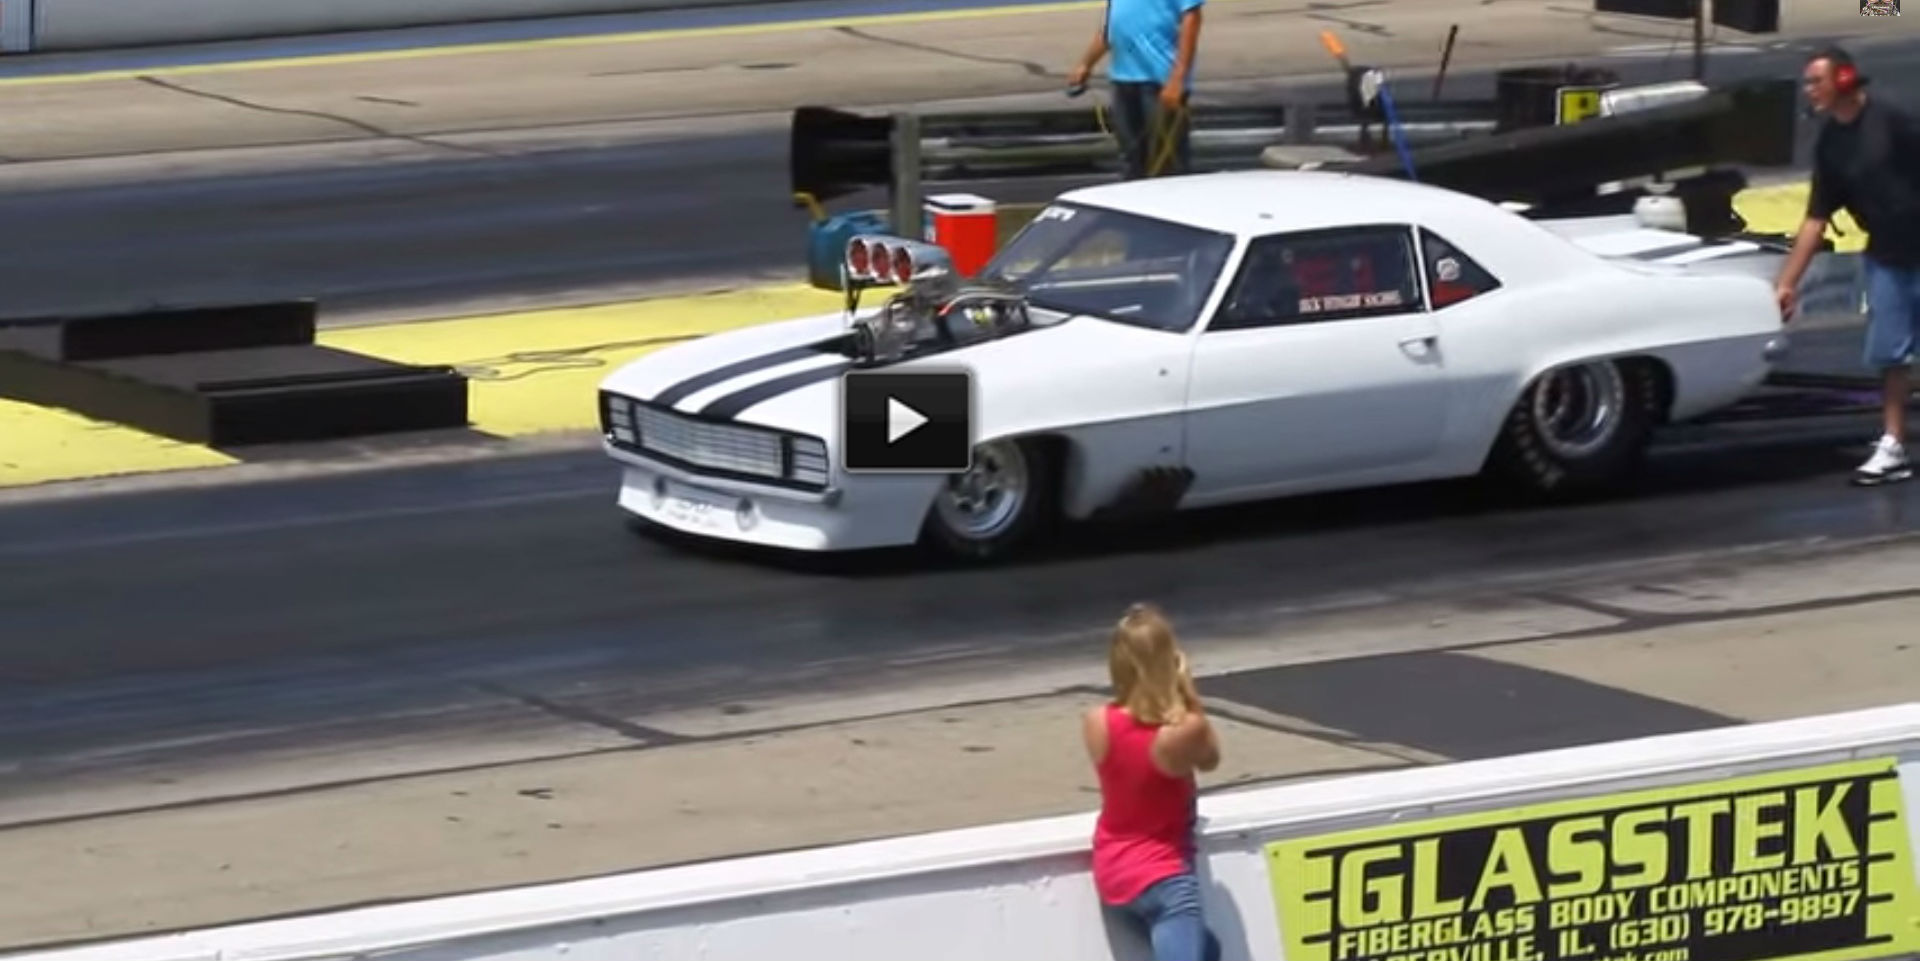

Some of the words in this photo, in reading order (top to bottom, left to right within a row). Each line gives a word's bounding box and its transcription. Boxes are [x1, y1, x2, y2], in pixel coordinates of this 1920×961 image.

[1338, 782, 1859, 929] GLASSTEK
[1338, 905, 1536, 960] FIBERGLASS
[1550, 890, 1635, 930] BODY
[1650, 859, 1860, 914] COMPONENTS
[1368, 934, 1544, 961] VILLE,
[1559, 928, 1596, 957] IL.
[1609, 912, 1690, 949] (630)
[1704, 888, 1861, 937] 978-9897
